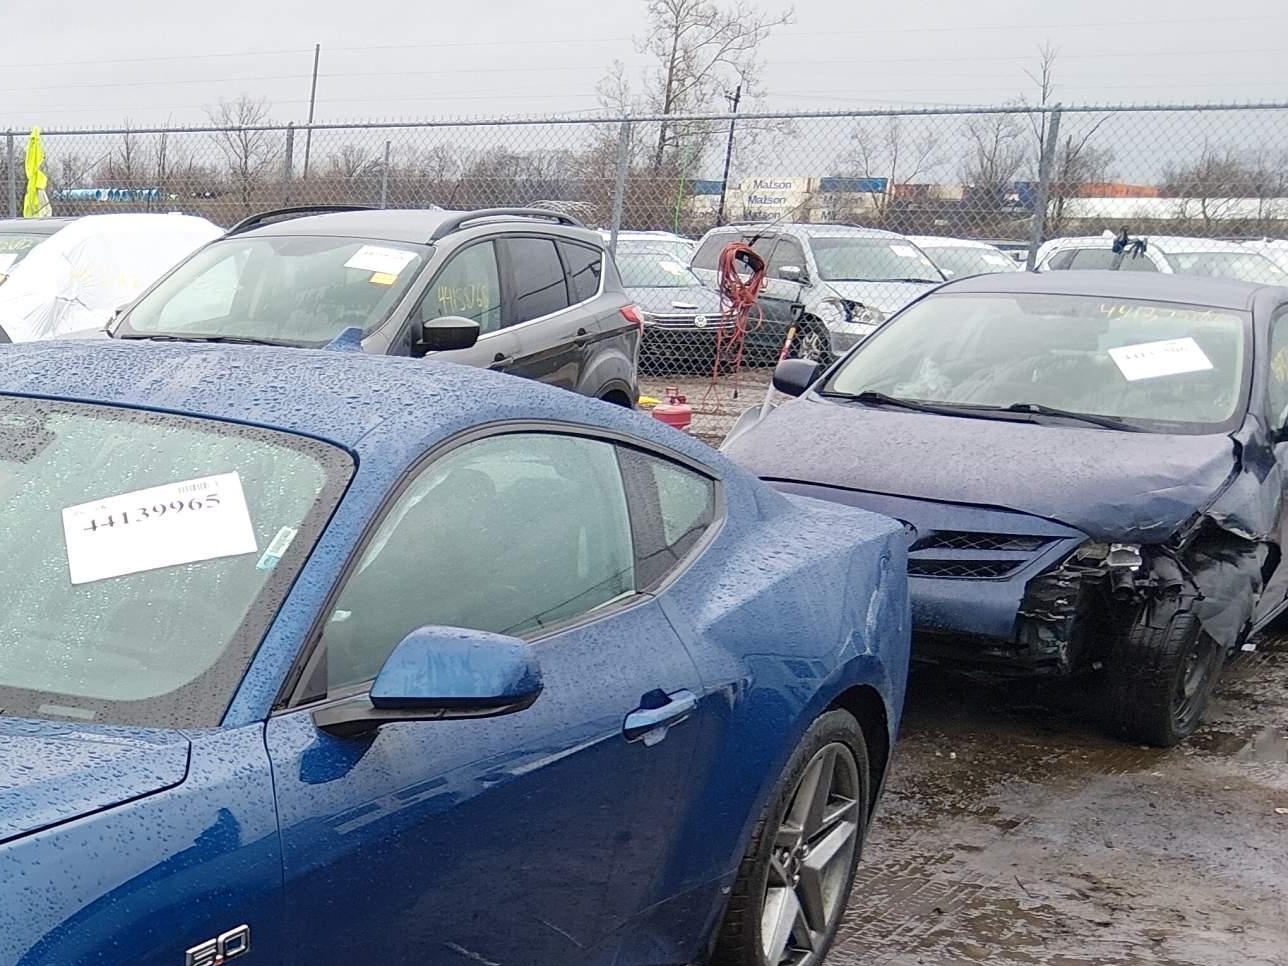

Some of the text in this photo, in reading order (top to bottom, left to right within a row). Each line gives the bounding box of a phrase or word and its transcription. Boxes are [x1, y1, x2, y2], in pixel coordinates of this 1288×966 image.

[753, 179, 792, 189] Matson
[748, 195, 786, 205] Matson
[83, 493, 221, 532] 44139965
